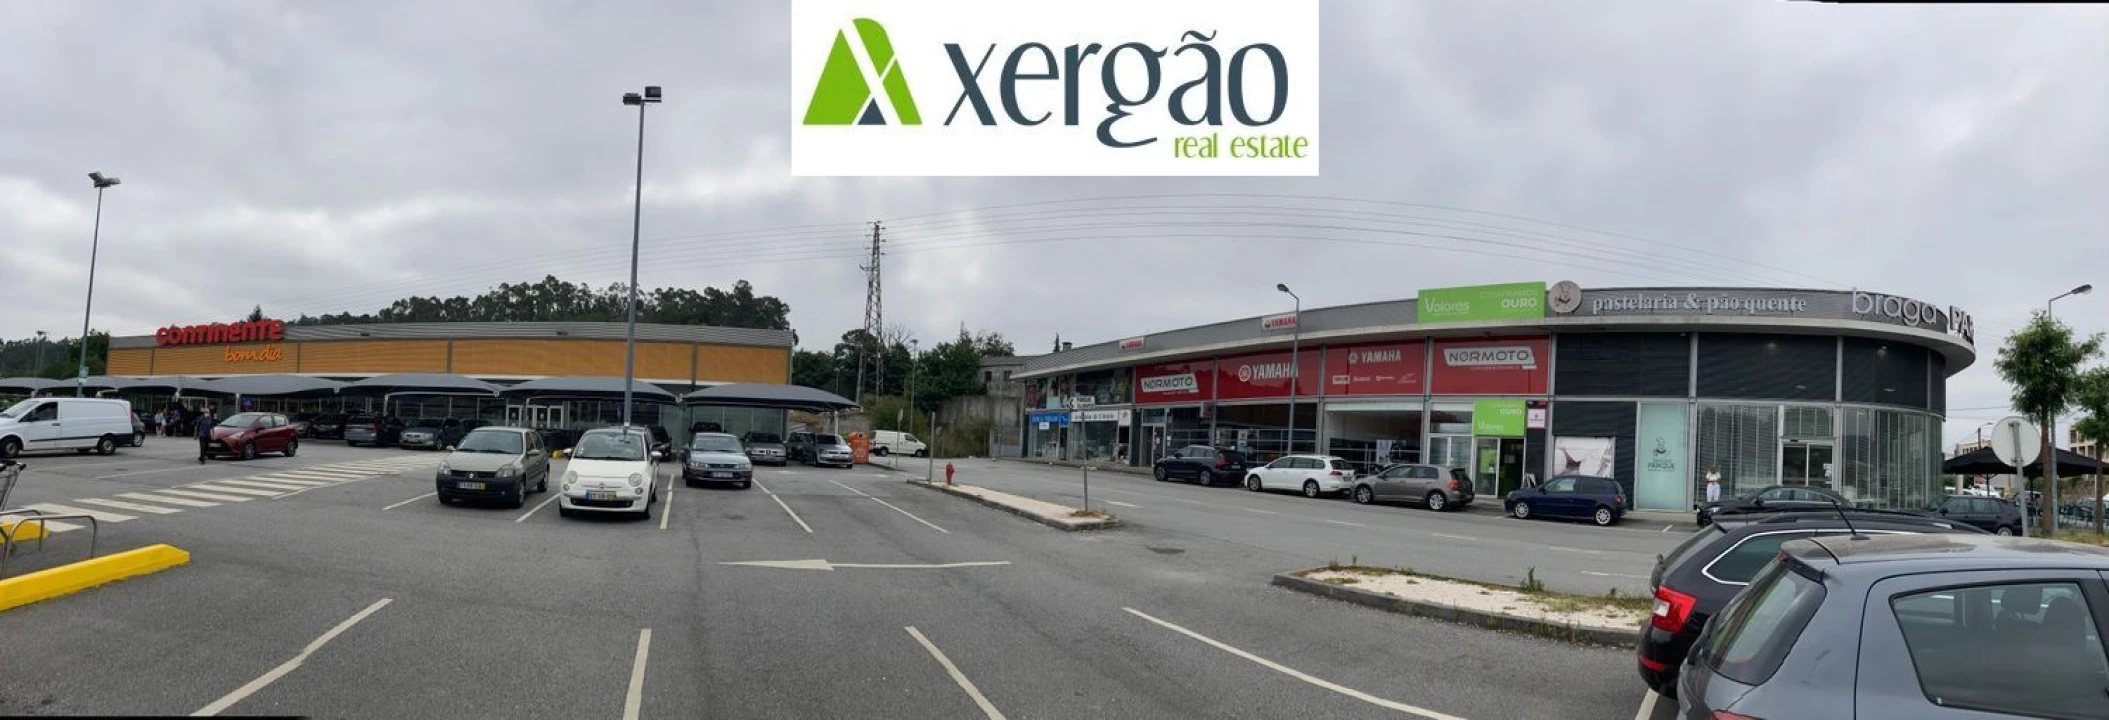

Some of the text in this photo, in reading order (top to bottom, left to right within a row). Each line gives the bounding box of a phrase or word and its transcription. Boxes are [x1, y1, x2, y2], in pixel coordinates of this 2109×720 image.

[1425, 298, 1470, 313] Valores
[1501, 298, 1538, 309] OURO
[1592, 293, 1807, 315] pastelaria & pão quente
[1852, 287, 1937, 327] braga
[1271, 316, 1298, 327] YAMAHA
[1361, 350, 1402, 363] YAMAHA
